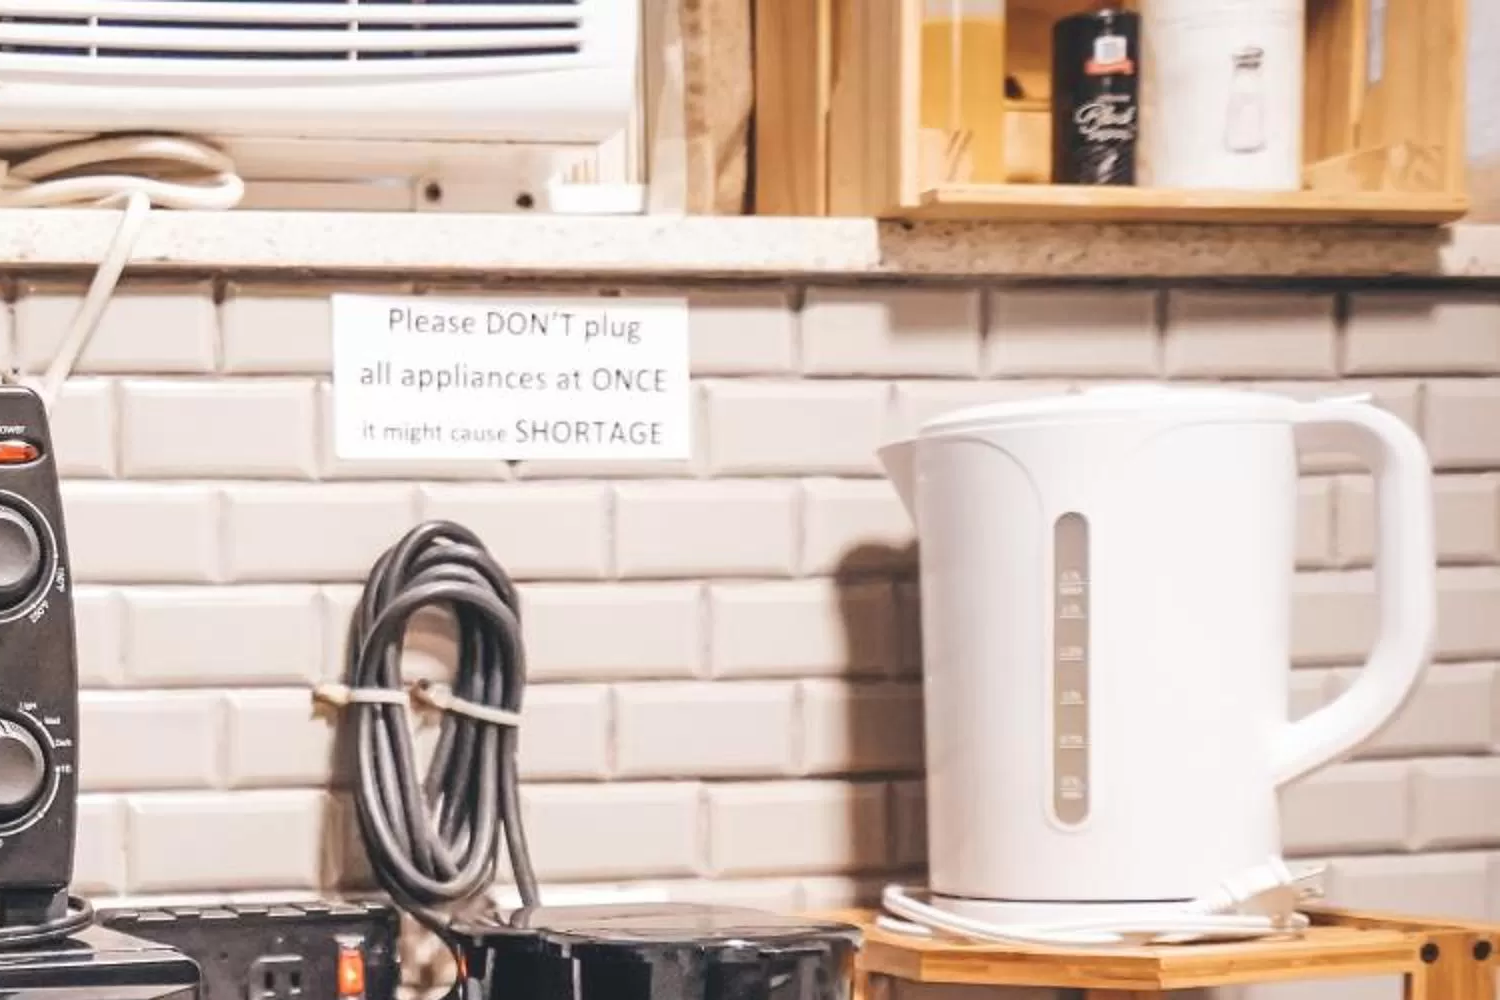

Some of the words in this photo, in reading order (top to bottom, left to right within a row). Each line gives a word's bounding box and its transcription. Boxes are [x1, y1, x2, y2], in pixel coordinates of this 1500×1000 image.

[389, 307, 477, 335] Please
[486, 310, 575, 336] DON'T
[584, 311, 642, 344] plug
[360, 361, 392, 386] all
[400, 363, 548, 392] appliances
[556, 369, 583, 391] at
[592, 367, 668, 393] ONCE
[362, 421, 376, 440] it
[383, 421, 443, 445] might
[450, 425, 507, 444] cause
[515, 419, 664, 446] SHORTAGE
